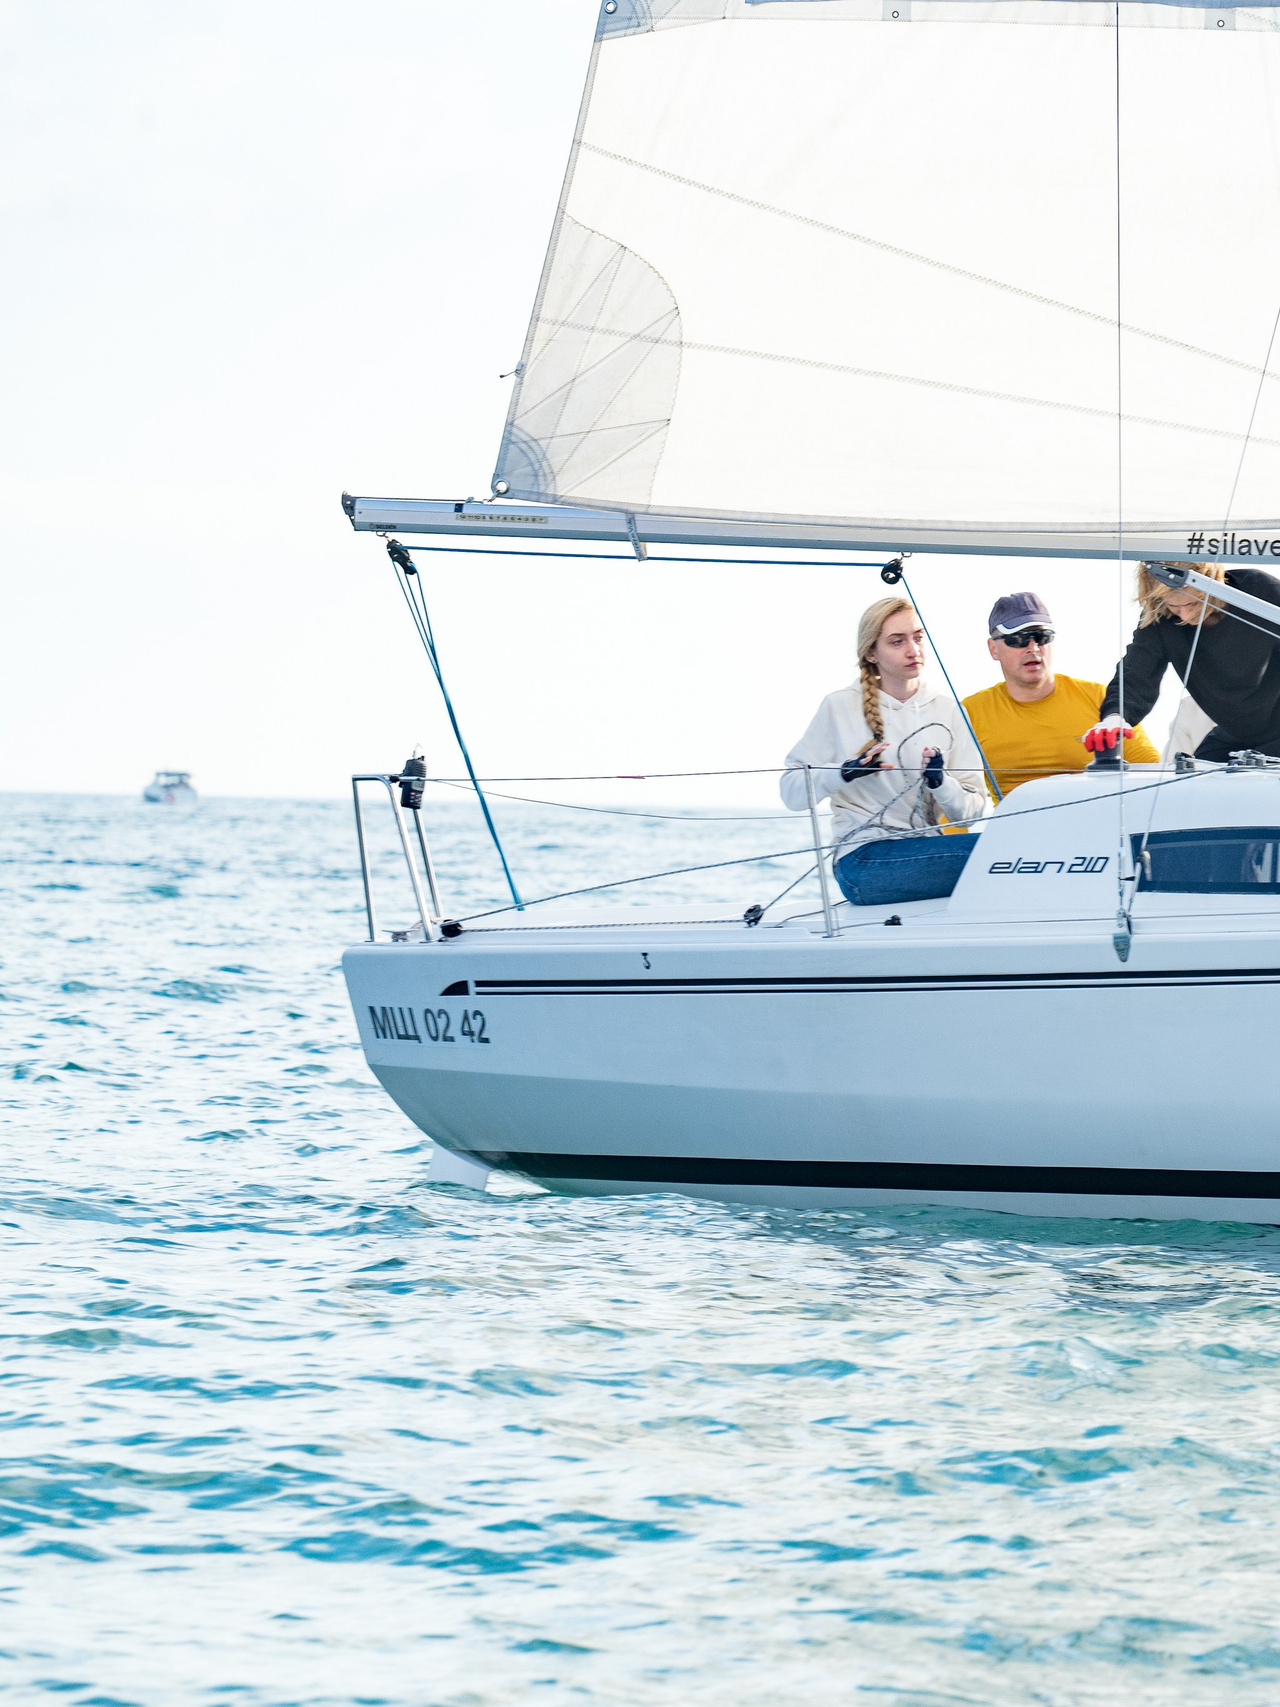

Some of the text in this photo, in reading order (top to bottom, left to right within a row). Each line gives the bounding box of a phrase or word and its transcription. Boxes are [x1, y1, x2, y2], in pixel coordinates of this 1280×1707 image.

[988, 857, 1065, 875] elan
[368, 1005, 491, 1044] МЩ 02 42
